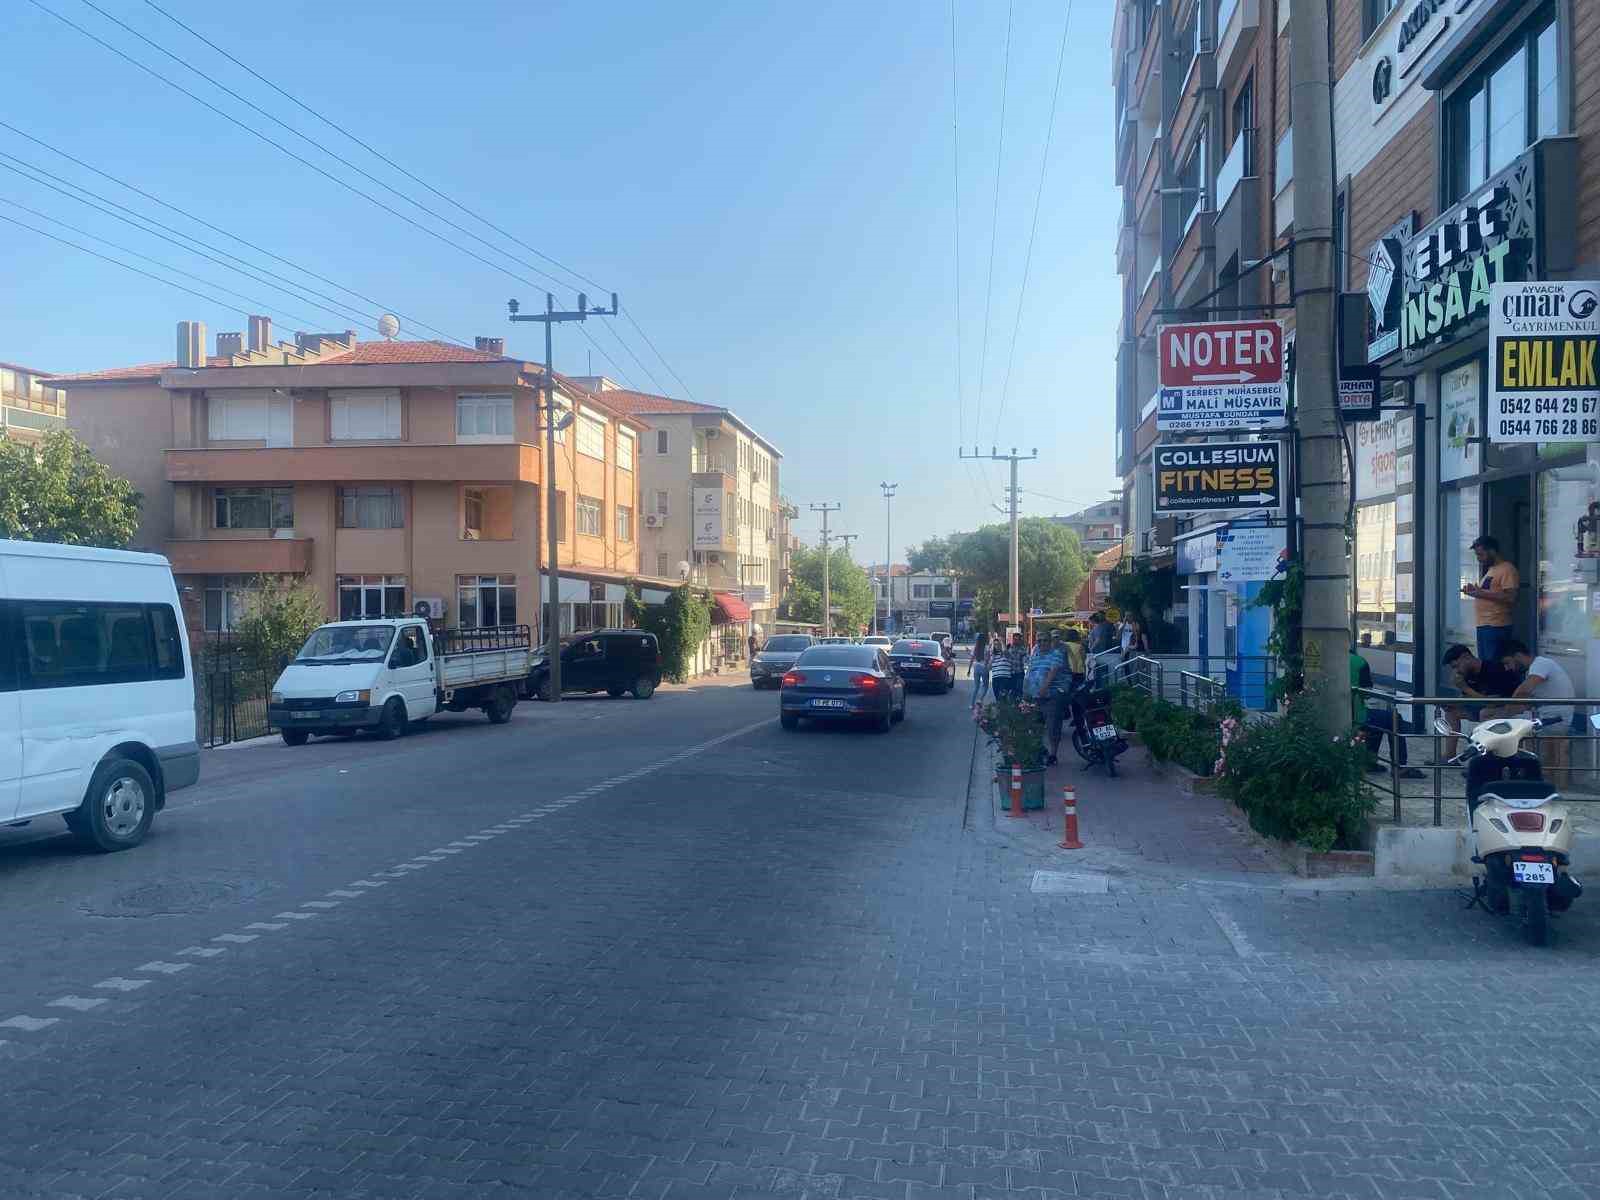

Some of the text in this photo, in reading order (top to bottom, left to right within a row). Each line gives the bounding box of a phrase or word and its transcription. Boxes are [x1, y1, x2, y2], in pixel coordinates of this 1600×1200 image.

[1170, 328, 1275, 368] NOTER
[1503, 340, 1598, 388] EMLAK
[1224, 396, 1281, 410] MÜŞAVİR
[1500, 397, 1598, 414] 0542 644 29 67
[1500, 418, 1597, 436] 0544 766 28 86
[1159, 448, 1276, 466] COLLESIUM
[1160, 467, 1275, 492] FITNESS
[1515, 863, 1527, 871] 17
